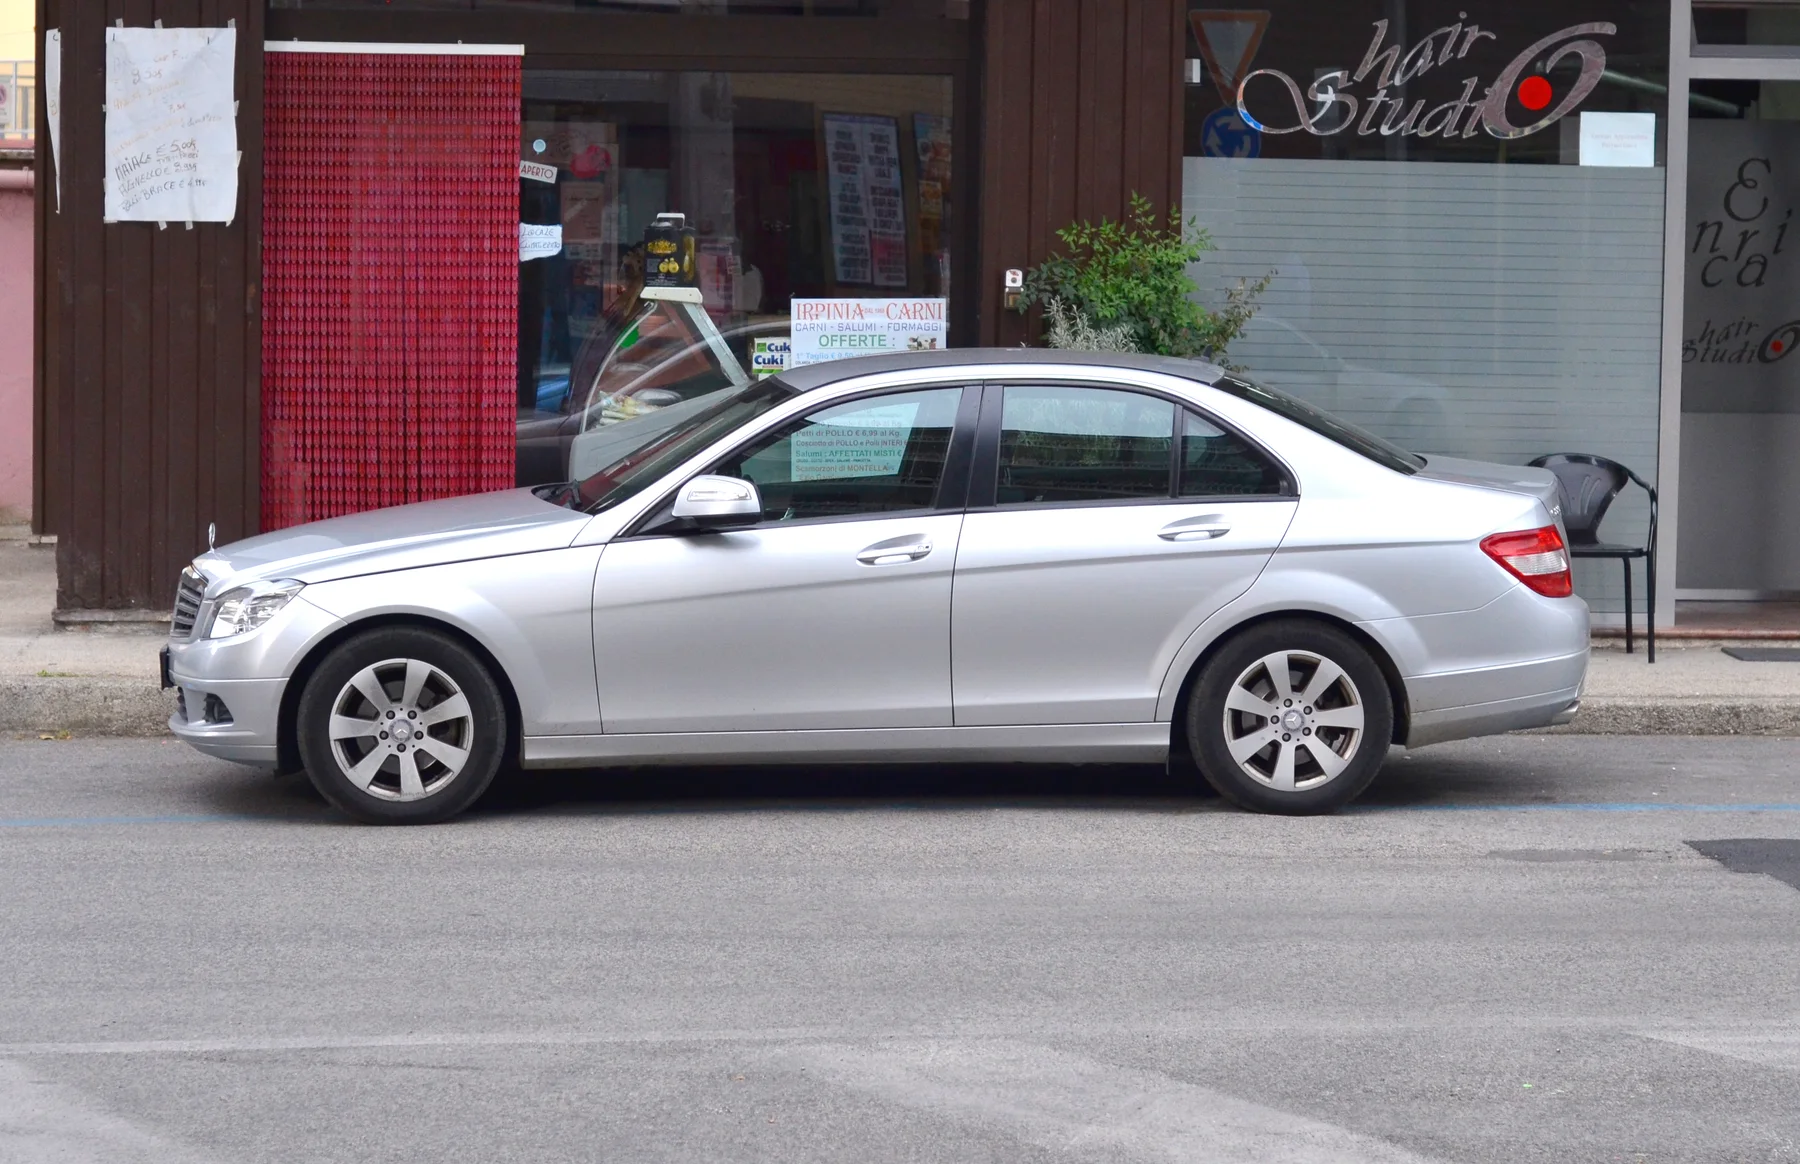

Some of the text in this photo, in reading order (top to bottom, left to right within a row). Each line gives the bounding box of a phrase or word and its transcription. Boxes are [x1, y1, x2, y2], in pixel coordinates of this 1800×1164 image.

[1353, 11, 1496, 90] hair
[520, 164, 554, 179] APERTO
[796, 302, 865, 321] IRPINIA
[886, 302, 943, 321] CARNI
[795, 322, 827, 332] CARNI
[837, 322, 877, 332] SALUMI
[887, 322, 942, 332] FORMAGGI
[1698, 316, 1759, 347] hair
[818, 334, 887, 347] OFFERTE
[754, 354, 784, 365] Cuki
[806, 352, 829, 361] Taglio
[825, 429, 853, 437] POLLO
[855, 429, 861, 437] €
[880, 429, 887, 437] al
[795, 450, 822, 458] Salumi
[829, 449, 872, 457] AFFETTATI
[873, 449, 896, 457] MISTI
[839, 463, 846, 471] di
[847, 464, 889, 472] MONTELLA
